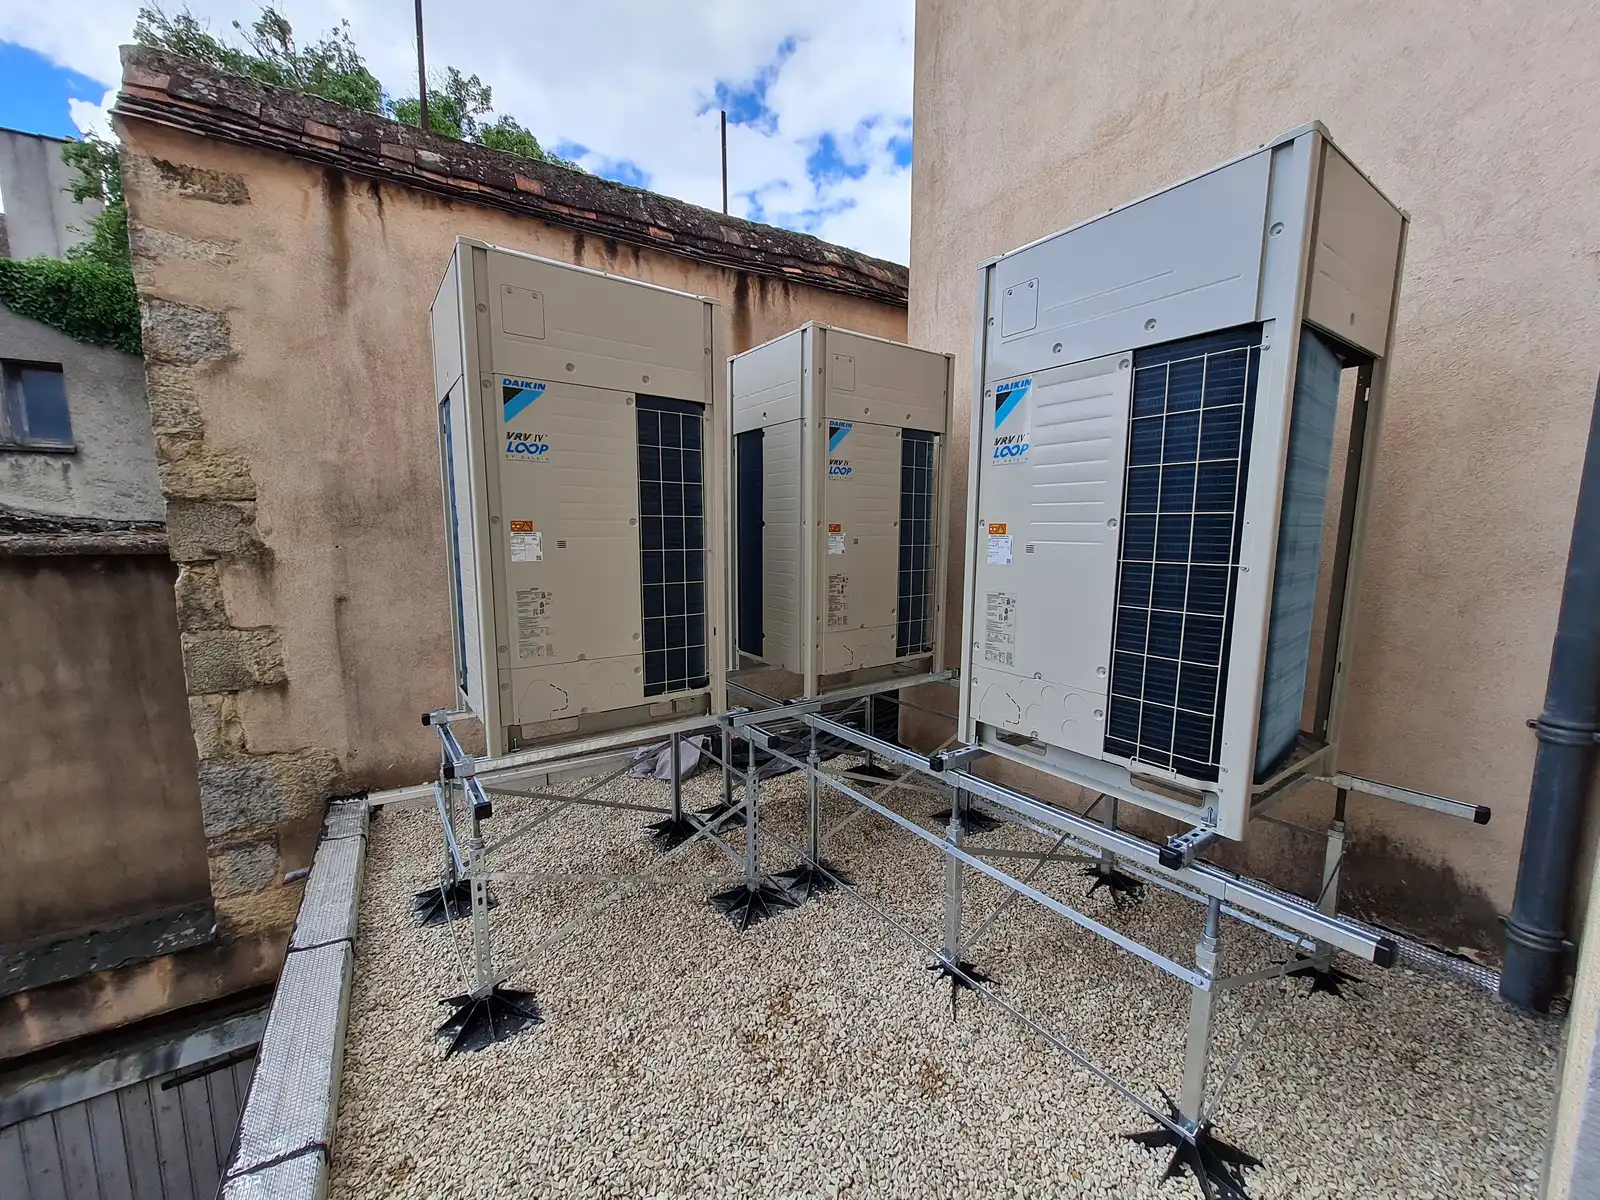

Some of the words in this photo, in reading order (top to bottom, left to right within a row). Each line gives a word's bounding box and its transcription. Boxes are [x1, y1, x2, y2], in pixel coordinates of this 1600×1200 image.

[502, 378, 546, 391] DAIKIN
[995, 378, 1033, 392] DAIKIN
[829, 420, 853, 429] DAIKIN
[505, 431, 532, 442] VRV
[994, 434, 1016, 446] VRV
[506, 441, 549, 455] LOOP
[993, 443, 1030, 459] LOOP
[828, 466, 852, 475] LOOP
